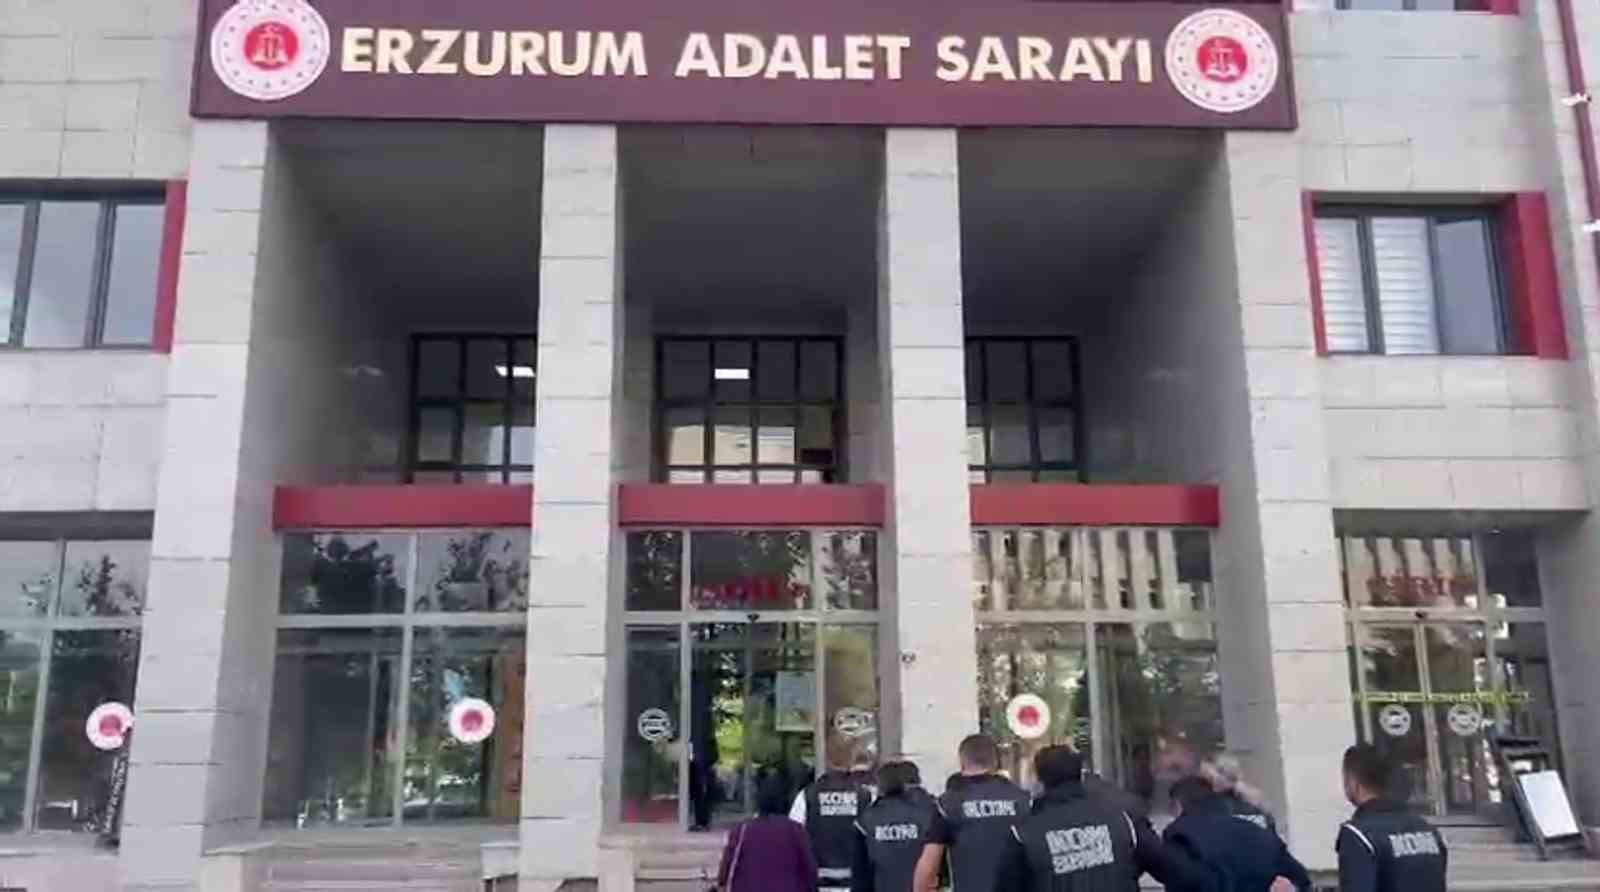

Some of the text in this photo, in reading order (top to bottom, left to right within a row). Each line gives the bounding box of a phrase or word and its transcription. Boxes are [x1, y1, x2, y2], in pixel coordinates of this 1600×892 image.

[340, 27, 1153, 83] ERZURUM ADALET SARAYI
